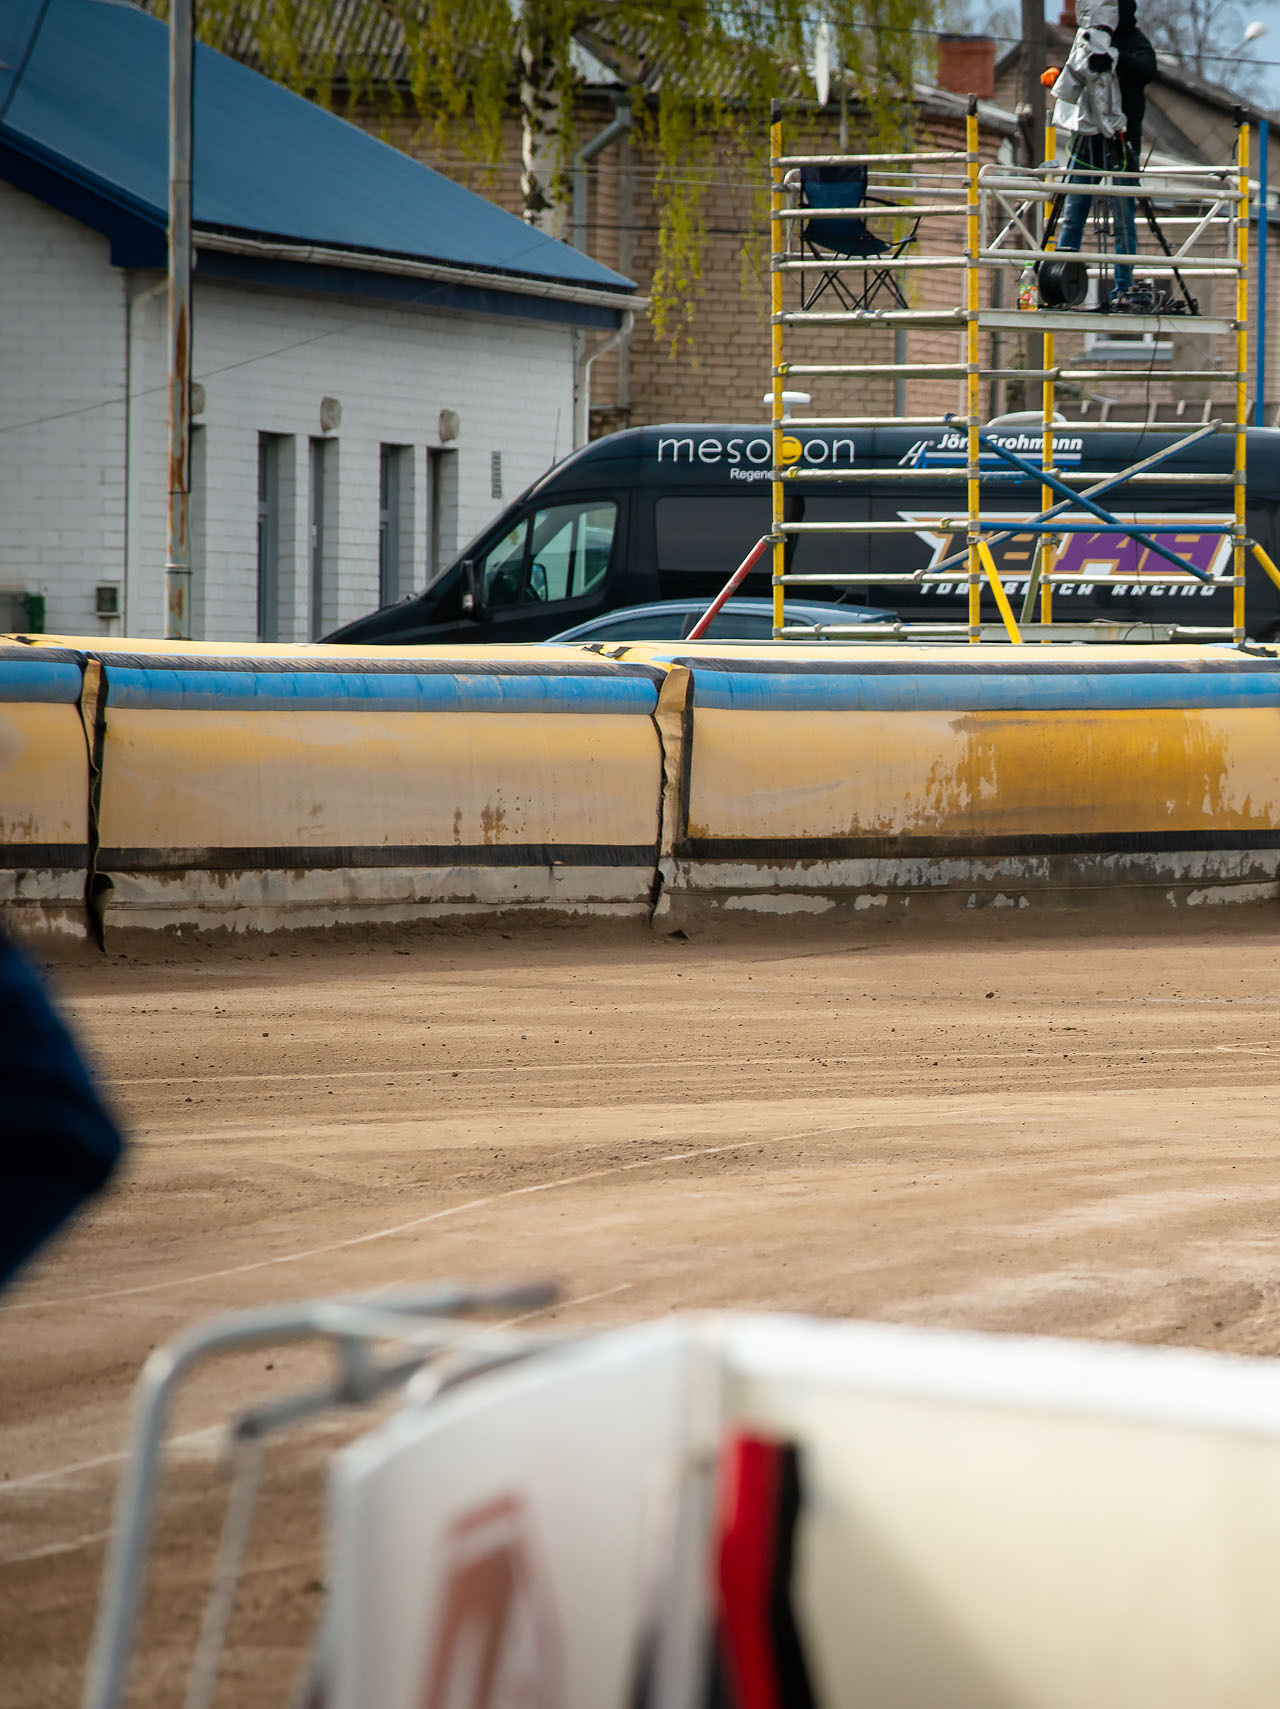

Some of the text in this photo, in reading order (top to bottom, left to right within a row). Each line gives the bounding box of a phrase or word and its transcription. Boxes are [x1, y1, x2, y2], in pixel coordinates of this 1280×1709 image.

[936, 433, 1083, 452] Jör Grohmnn
[1003, 582, 1095, 597] BCH
[1110, 583, 1217, 597] RACING
